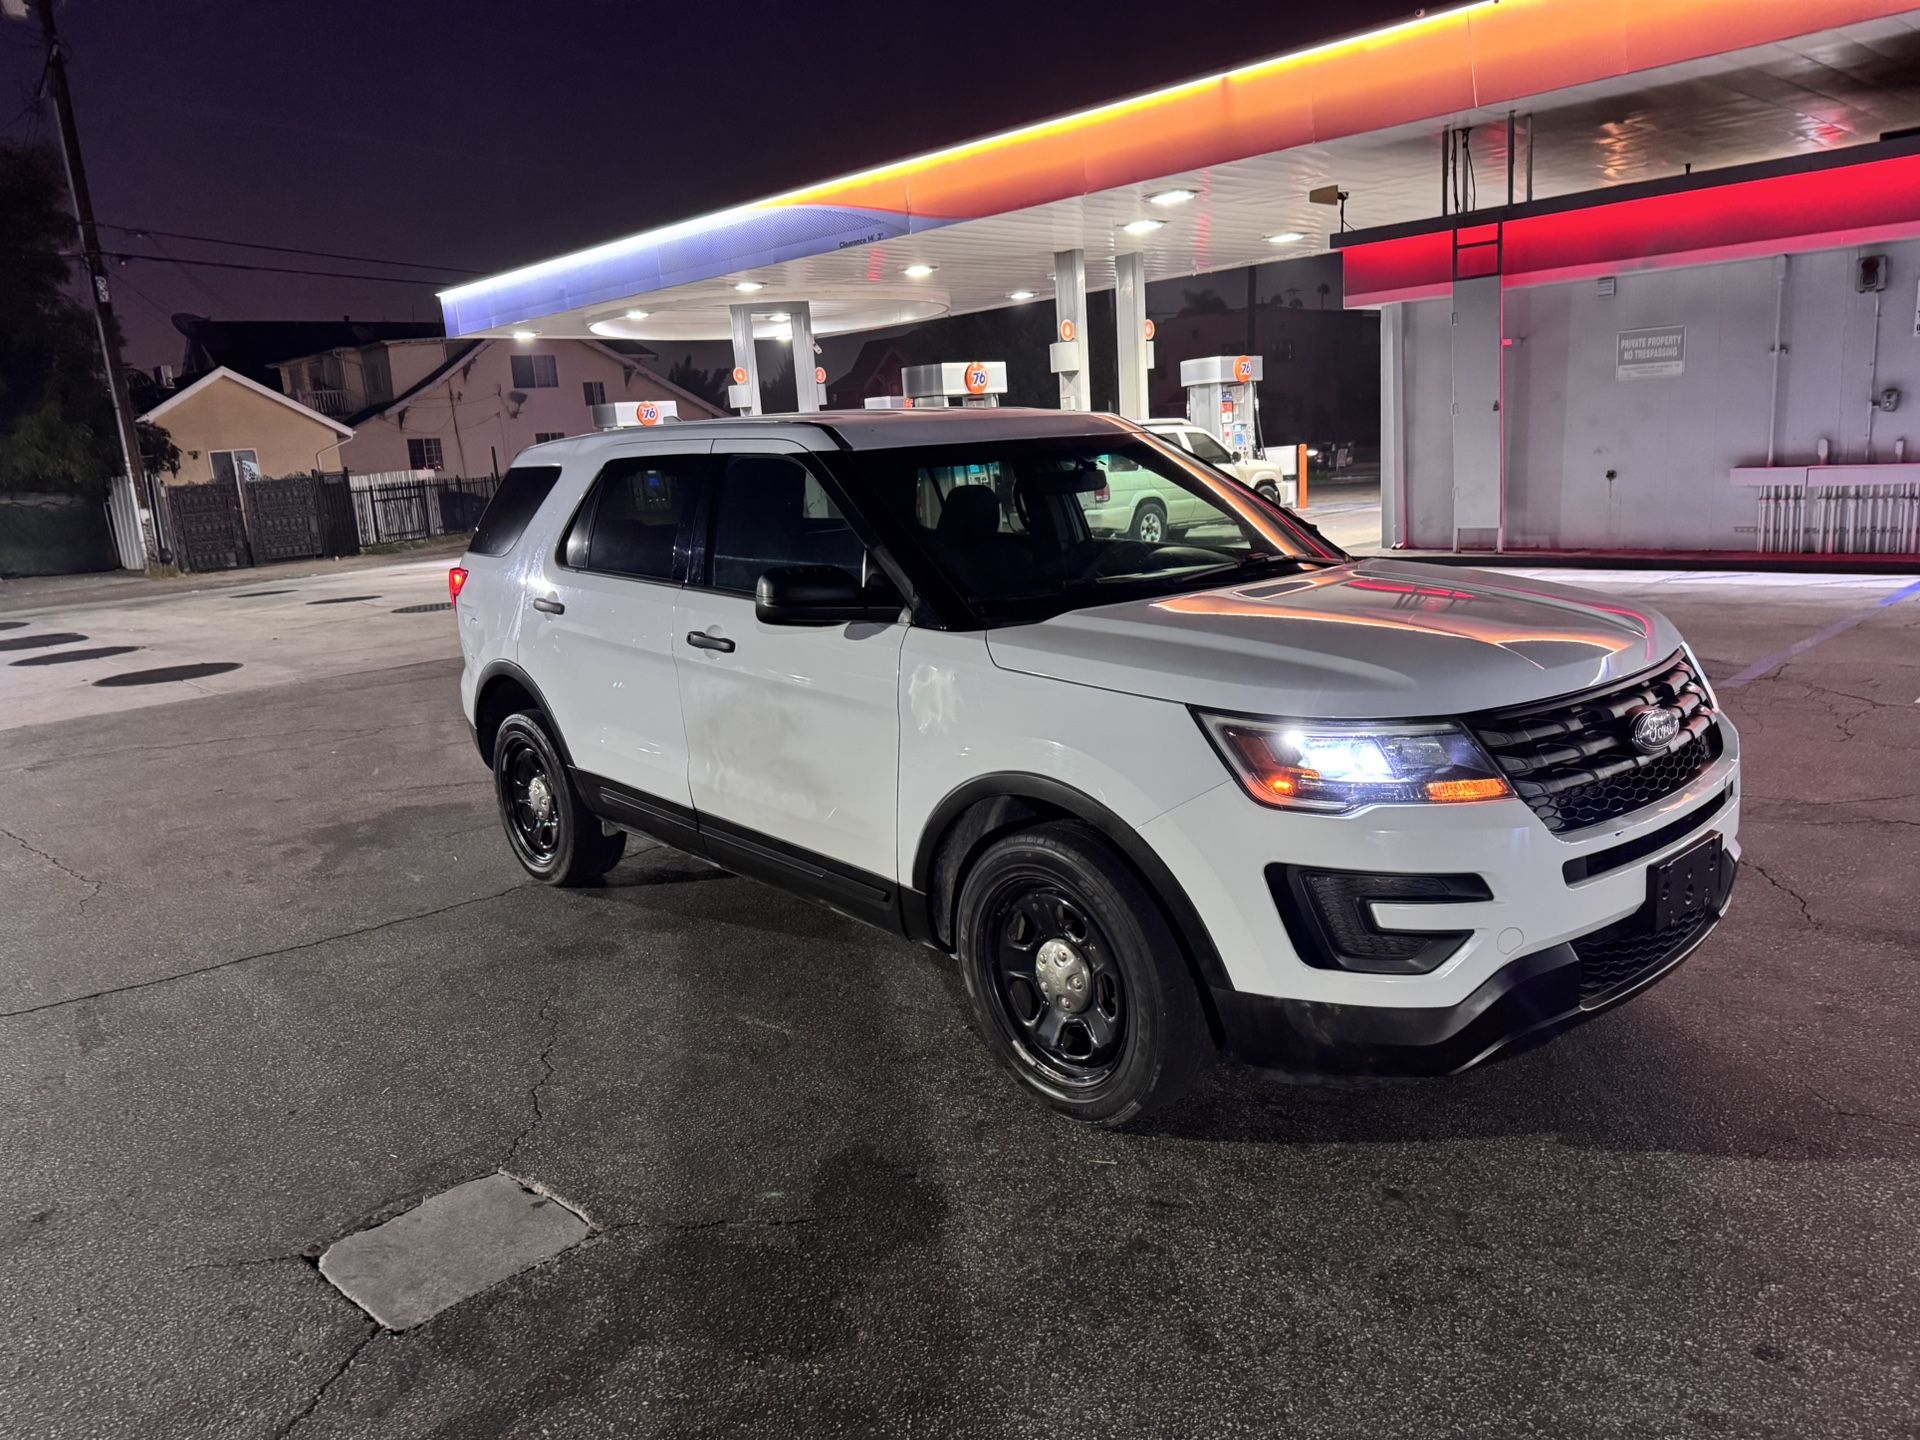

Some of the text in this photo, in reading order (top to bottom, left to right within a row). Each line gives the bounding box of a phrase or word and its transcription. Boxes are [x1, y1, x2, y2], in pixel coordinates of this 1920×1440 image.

[839, 238, 867, 249] Clearance
[1620, 334, 1682, 351] PRIVATE PROPERTY
[1624, 346, 1678, 361] NO TRESPASSING
[1241, 362, 1251, 374] 76
[972, 372, 986, 385] 76
[643, 408, 656, 419] 76
[1642, 715, 1674, 743] Ford
